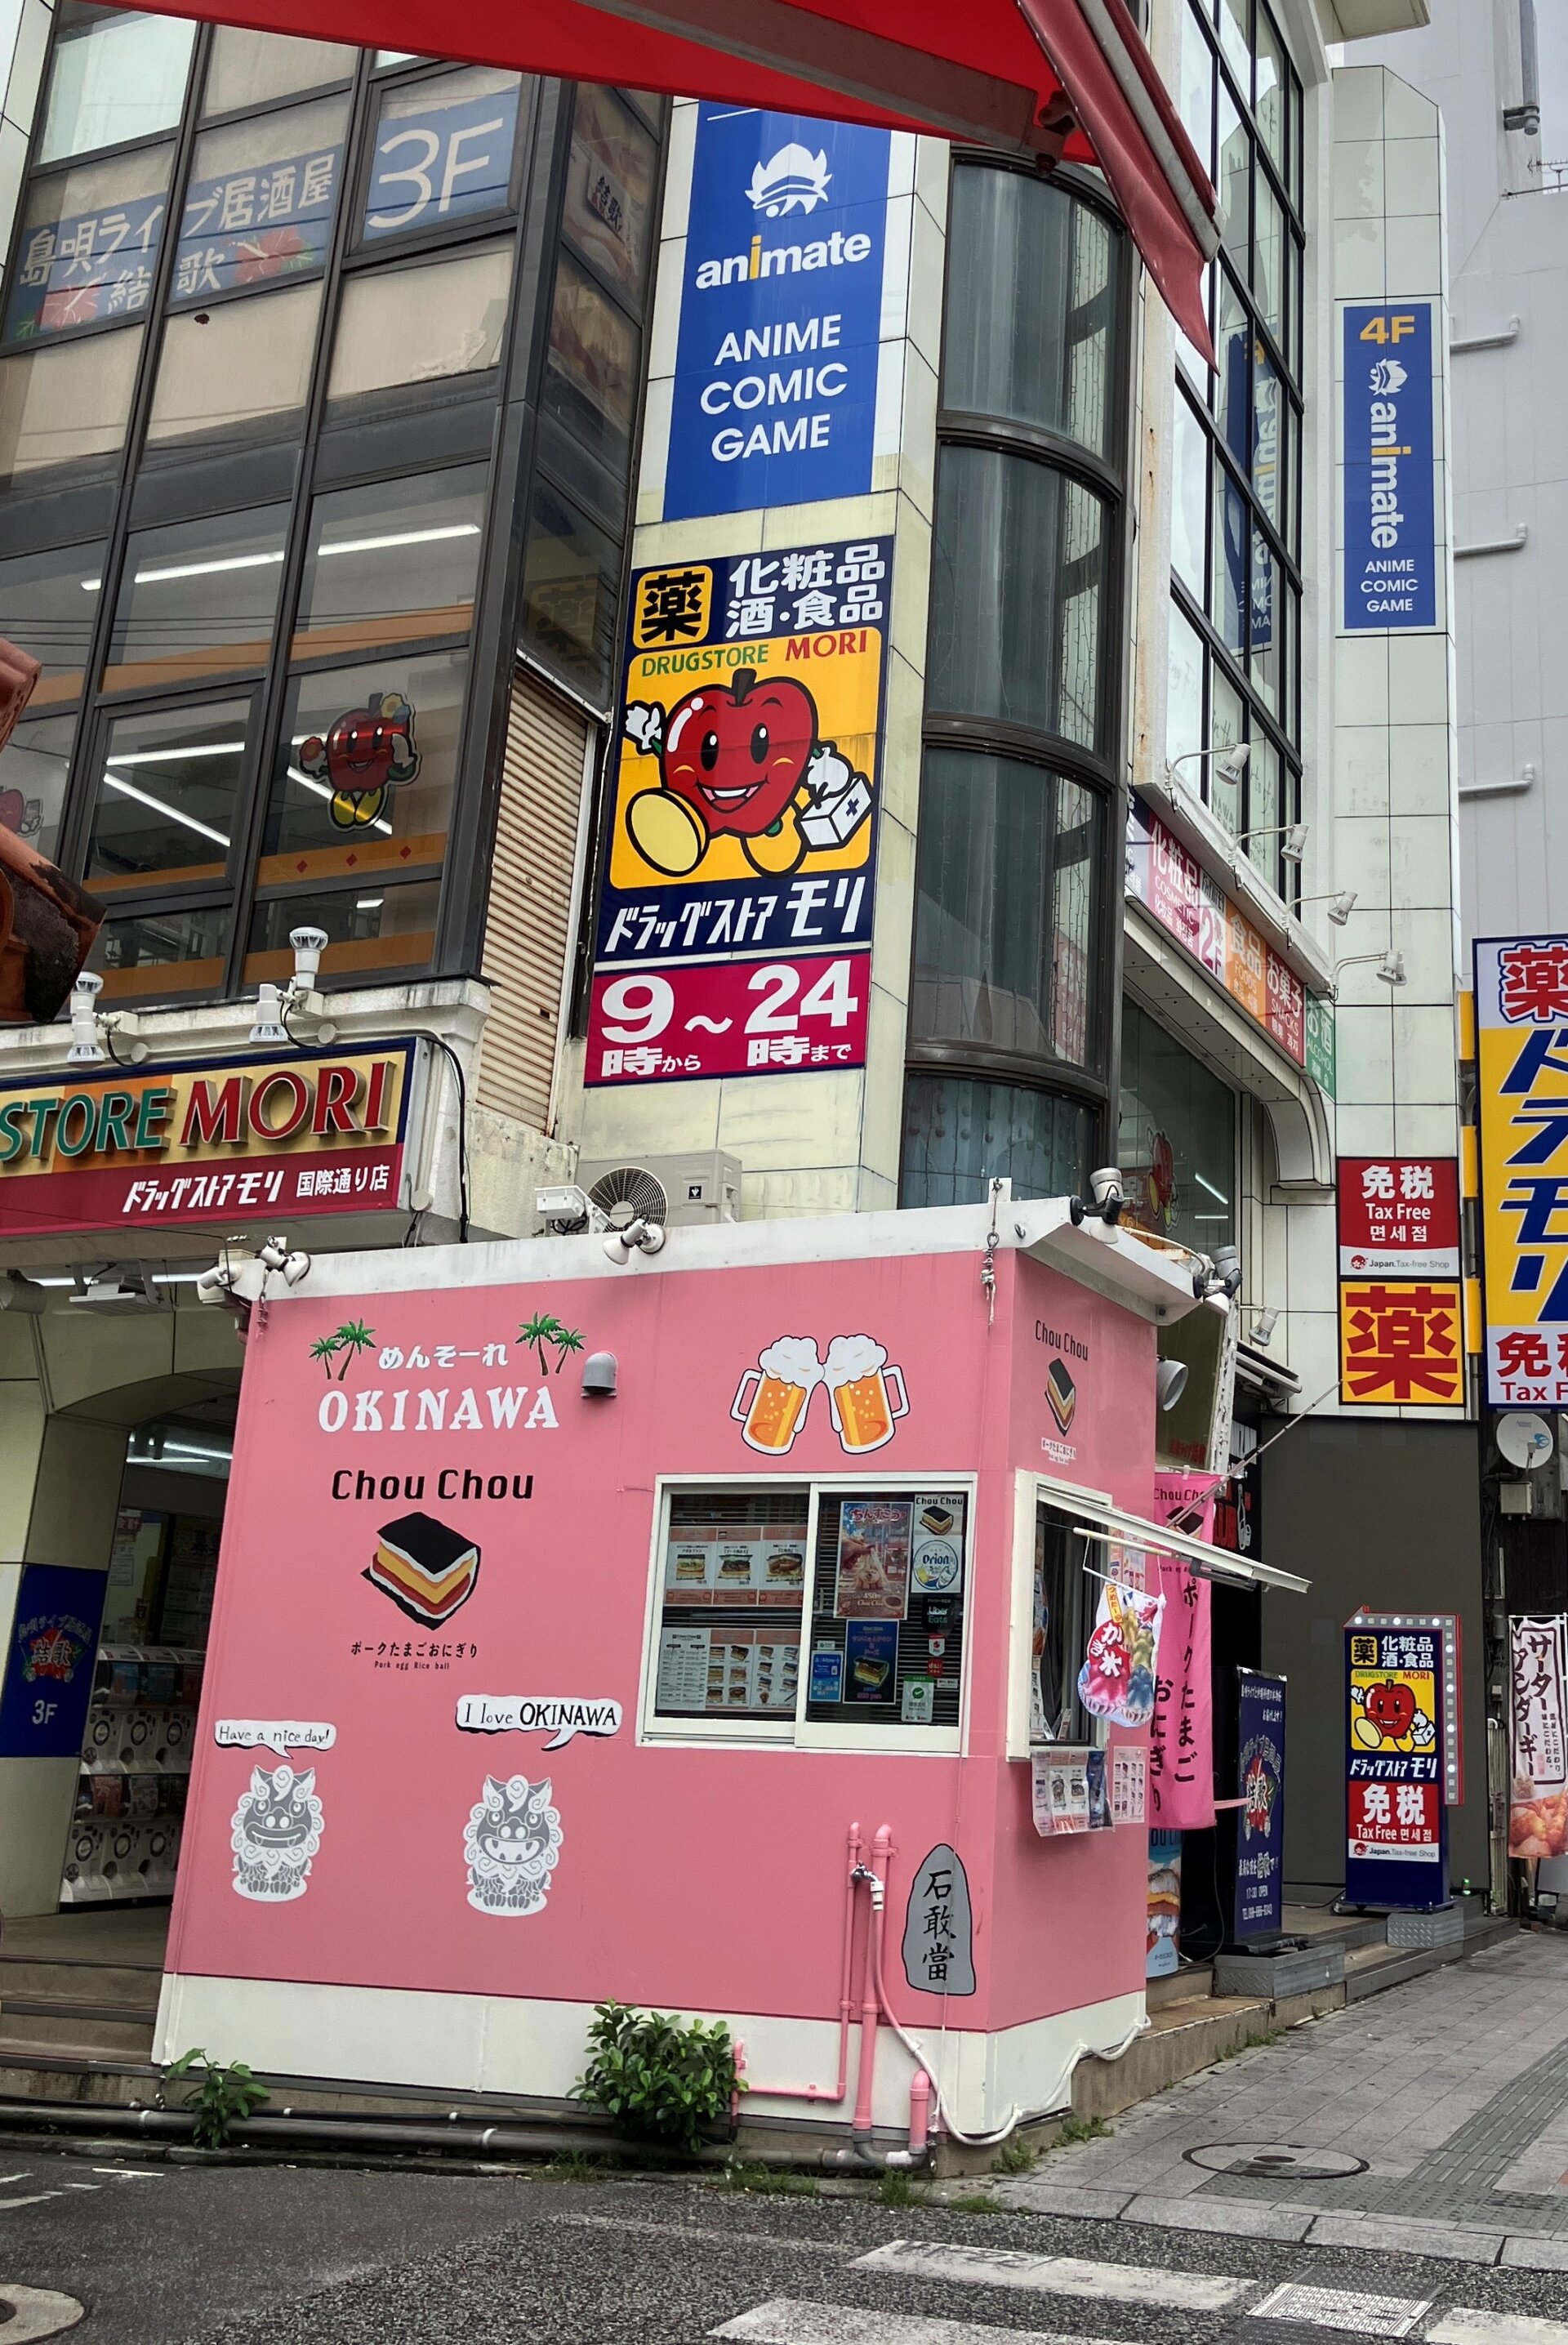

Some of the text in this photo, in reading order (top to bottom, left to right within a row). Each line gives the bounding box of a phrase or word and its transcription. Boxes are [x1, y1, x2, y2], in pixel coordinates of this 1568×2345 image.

[367, 118, 504, 230] 3F
[696, 231, 871, 290] animate
[714, 314, 842, 366] ANIME
[1359, 315, 1415, 345] 4F
[700, 363, 849, 415] COMIC
[710, 413, 831, 463] GAME
[1369, 401, 1412, 550] animate
[728, 542, 886, 598] 化粧品
[1360, 578, 1419, 593] COMIC
[1365, 559, 1415, 573] ANIME
[640, 570, 706, 644] 薬
[1366, 598, 1414, 613] GAME
[641, 630, 868, 677] DRUGSTORE MORI
[1152, 820, 1199, 909] 化粧品
[1155, 875, 1195, 925] COSMETIC
[1201, 906, 1223, 977] 2F
[1230, 914, 1262, 981] 食品
[1234, 960, 1258, 994] FOODS
[1267, 952, 1303, 1019] お菓子
[1503, 946, 1568, 1019] 薬
[1271, 998, 1299, 1037] SNACKS
[1307, 998, 1333, 1056] お酒
[601, 1035, 853, 1077] 時から 時まで
[179, 1060, 395, 1148] MORI
[122, 1164, 390, 1214] ドラッグストアモリ 国際通り店
[1361, 1165, 1435, 1200] 免税
[1365, 1203, 1431, 1220] Tax Free
[1429, 1259, 1450, 1268] Shop
[378, 1343, 509, 1371] めんそーれ
[1035, 1319, 1089, 1362] Chou Chou
[1346, 1286, 1458, 1398] 薬
[318, 1385, 559, 1432] OKINAWA
[1499, 1382, 1548, 1402] Tax
[332, 1468, 534, 1500] Chou Chou
[915, 1496, 964, 1505] Chou Chou
[922, 1553, 950, 1565] Orion
[350, 1640, 478, 1658] ポークたまごおにぎり
[1353, 1638, 1375, 1664] 薬
[1381, 1635, 1434, 1652] 化粧品
[374, 1661, 450, 1670] Pork egg Rice ball
[1173, 1577, 1199, 1784] ポークたまご
[1355, 1671, 1430, 1680] DRUGSTORE MORI
[1527, 1634, 1552, 1711] サーター
[32, 1699, 58, 1725] 3F
[464, 1701, 618, 1727] I love OKINAWA
[219, 1726, 252, 1742] Have
[256, 1731, 265, 1741] a
[273, 1728, 301, 1742] nice
[1362, 1783, 1426, 1826] 免税
[1356, 1823, 1397, 1840] Tax Free
[1419, 1849, 1436, 1858] Shop
[922, 1870, 957, 1982] 石敢當
